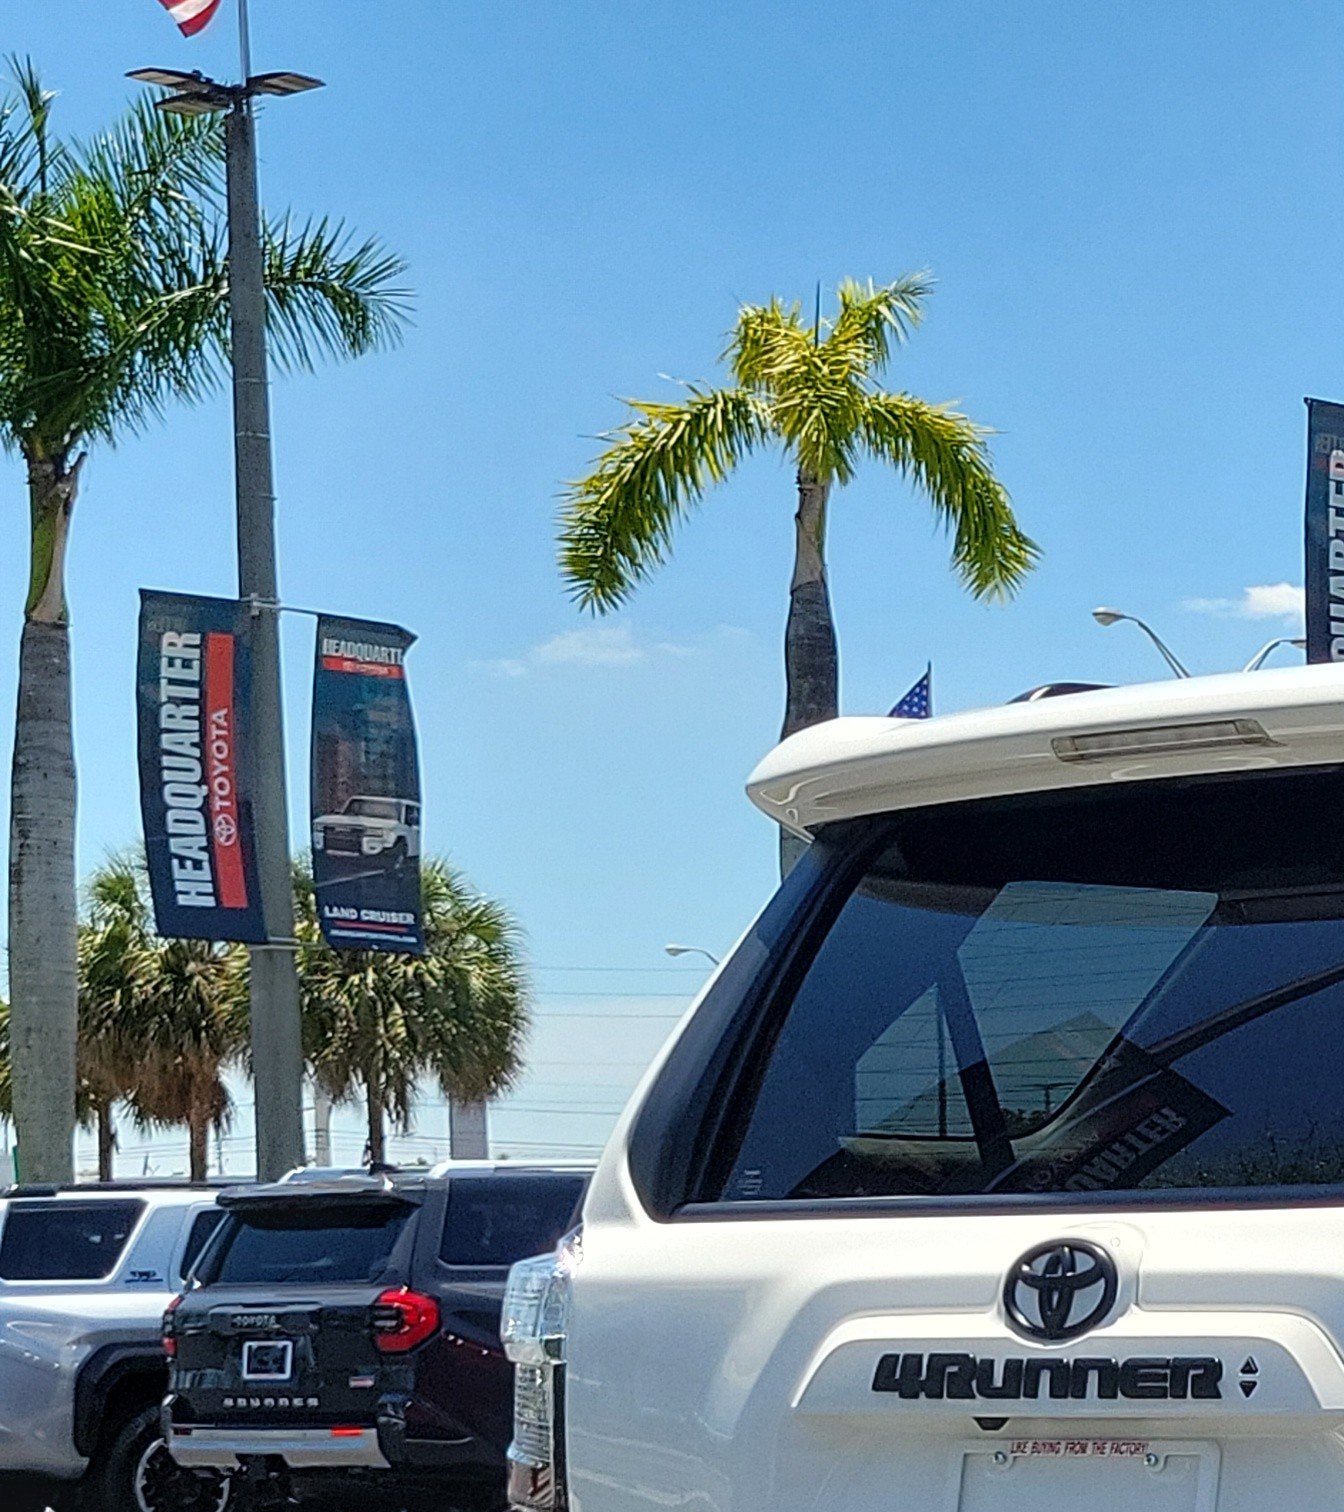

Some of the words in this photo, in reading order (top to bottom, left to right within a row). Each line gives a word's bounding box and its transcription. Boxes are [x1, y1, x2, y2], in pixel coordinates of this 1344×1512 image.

[160, 631, 217, 907] HEADQUARTER
[211, 707, 231, 811] TOYOTA
[324, 905, 358, 920] LAND
[360, 909, 416, 925] CRUISER
[1064, 1441, 1089, 1454] FROM
[1092, 1441, 1107, 1454] THE
